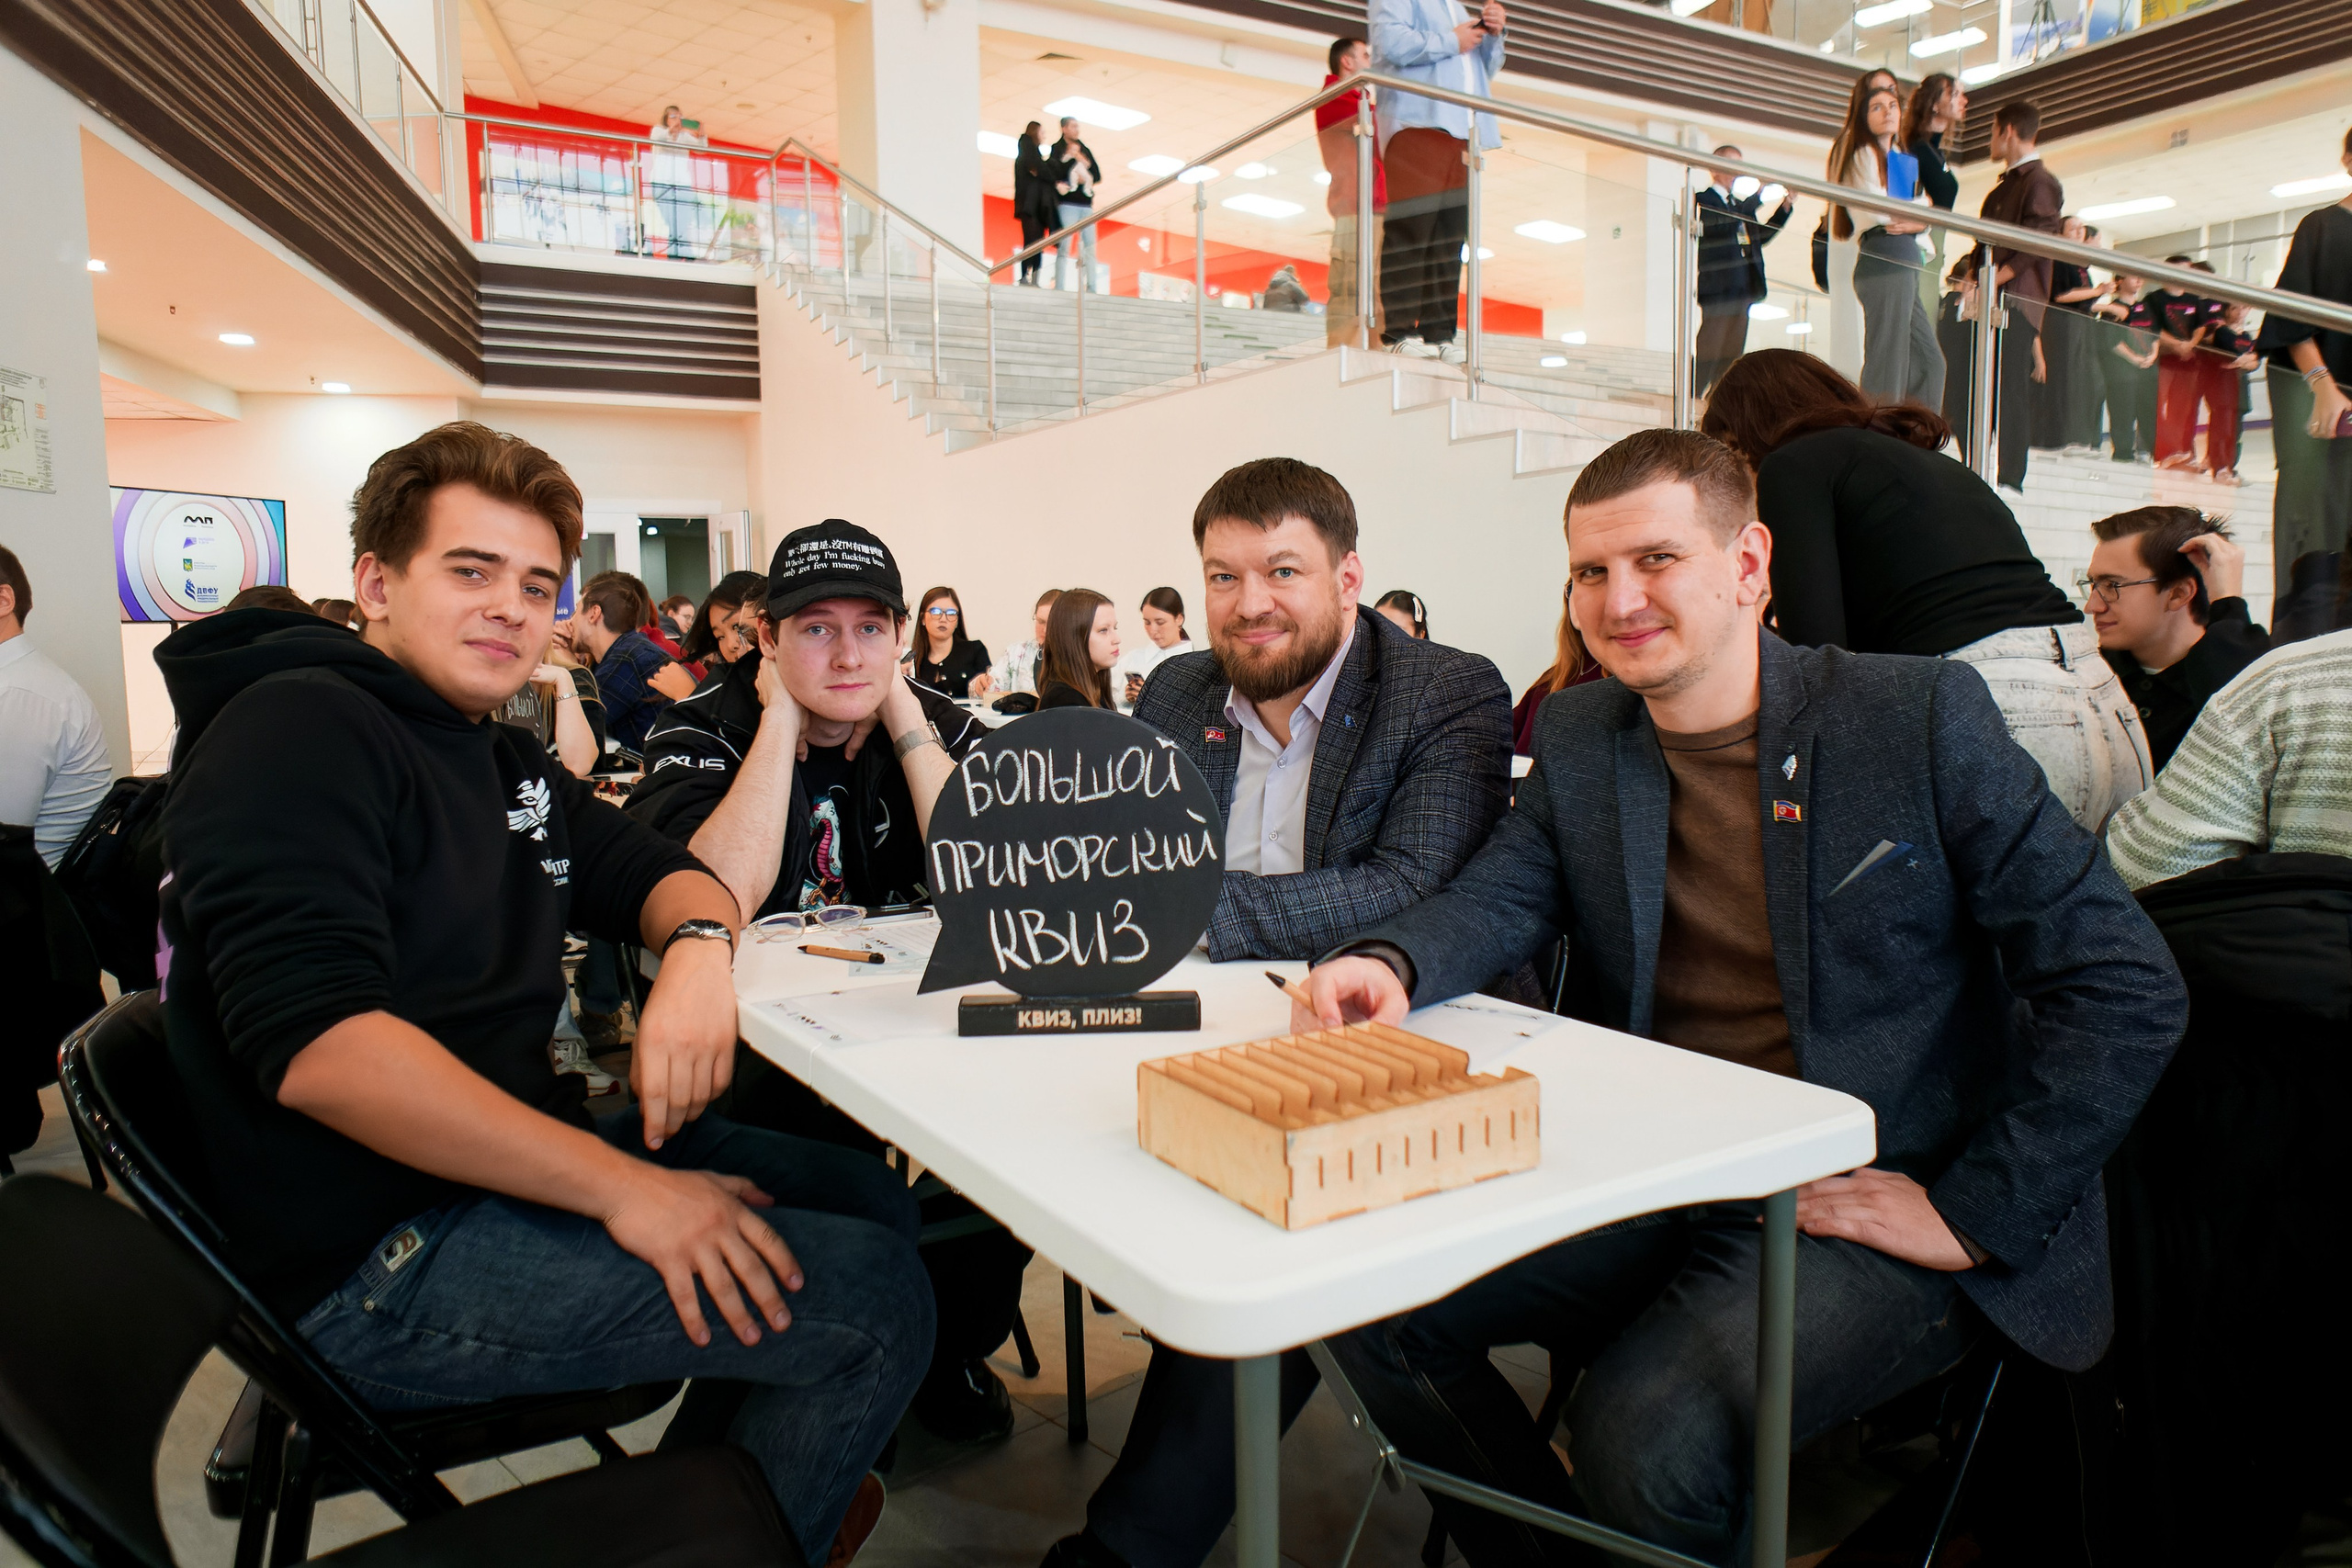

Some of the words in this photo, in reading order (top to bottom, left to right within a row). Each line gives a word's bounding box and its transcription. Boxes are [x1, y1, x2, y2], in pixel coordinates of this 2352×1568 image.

[797, 564, 810, 574] get
[813, 561, 829, 570] few
[831, 561, 863, 571] money.
[807, 553, 821, 562] day
[824, 551, 838, 559] I'm
[842, 552, 872, 565] fucking
[961, 736, 1182, 817] БОЛЬШОЙ
[931, 808, 1218, 894] ПРИМОРСКИЙ
[989, 899, 1149, 974] КВИЗ
[1017, 1010, 1078, 1030] КВИЗ,
[1082, 1007, 1142, 1026] ПЛИЗ!
